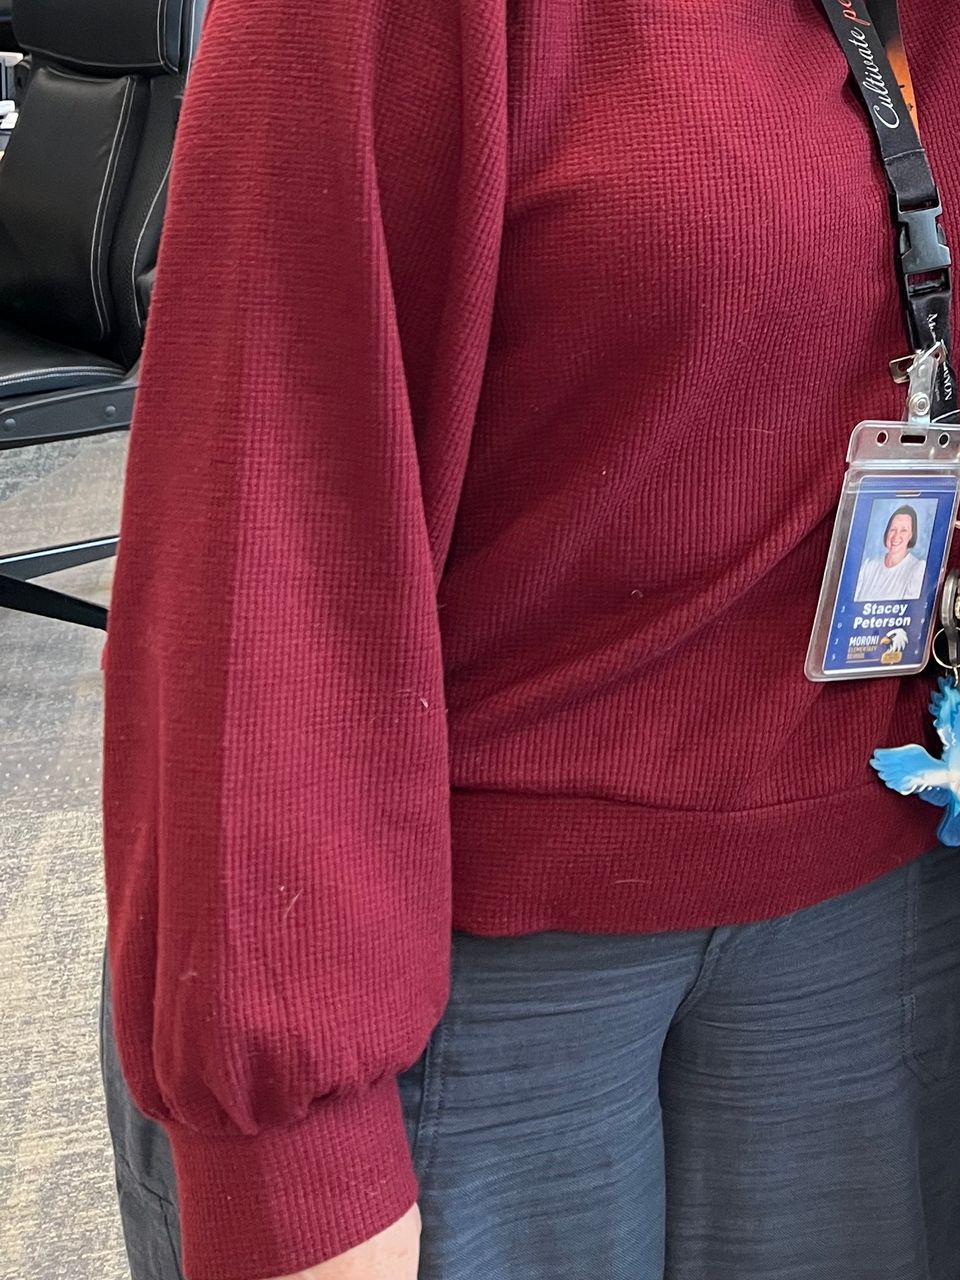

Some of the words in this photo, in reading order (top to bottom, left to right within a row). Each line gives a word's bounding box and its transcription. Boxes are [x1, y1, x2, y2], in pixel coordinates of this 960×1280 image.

[848, 27, 900, 129] Cultivate
[862, 602, 908, 616] Stacey
[853, 616, 911, 629] Peterson
[848, 635, 880, 646] MORONI
